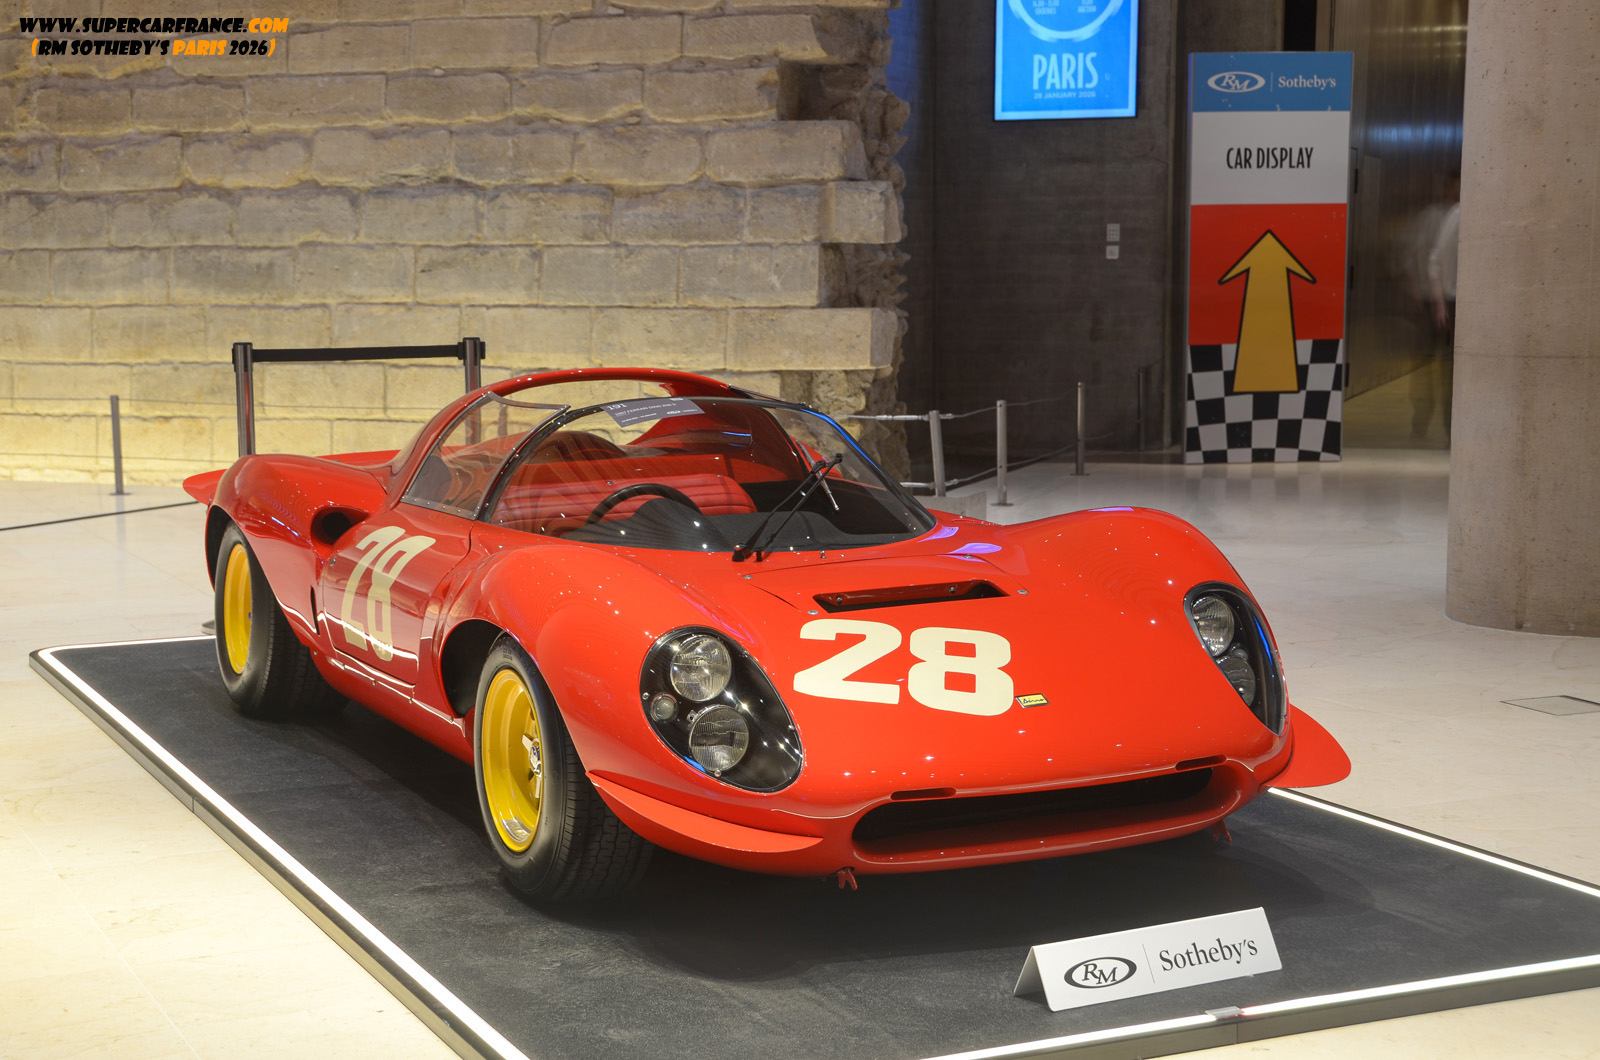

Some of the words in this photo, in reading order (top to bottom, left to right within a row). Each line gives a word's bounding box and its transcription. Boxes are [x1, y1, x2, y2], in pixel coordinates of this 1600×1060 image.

[1032, 52, 1099, 90] PARIS
[1220, 74, 1250, 91] RM
[1277, 74, 1337, 91] Sotheby's
[1044, 91, 1078, 99] JANUARY
[1078, 90, 1096, 98] 2026
[1226, 147, 1252, 169] CAR
[1256, 147, 1314, 169] DISPLAY
[607, 403, 628, 411] 191
[341, 525, 437, 662] 28
[793, 618, 1014, 717] 28
[1081, 962, 1118, 985] RM
[1158, 937, 1258, 972] Sotheby's
